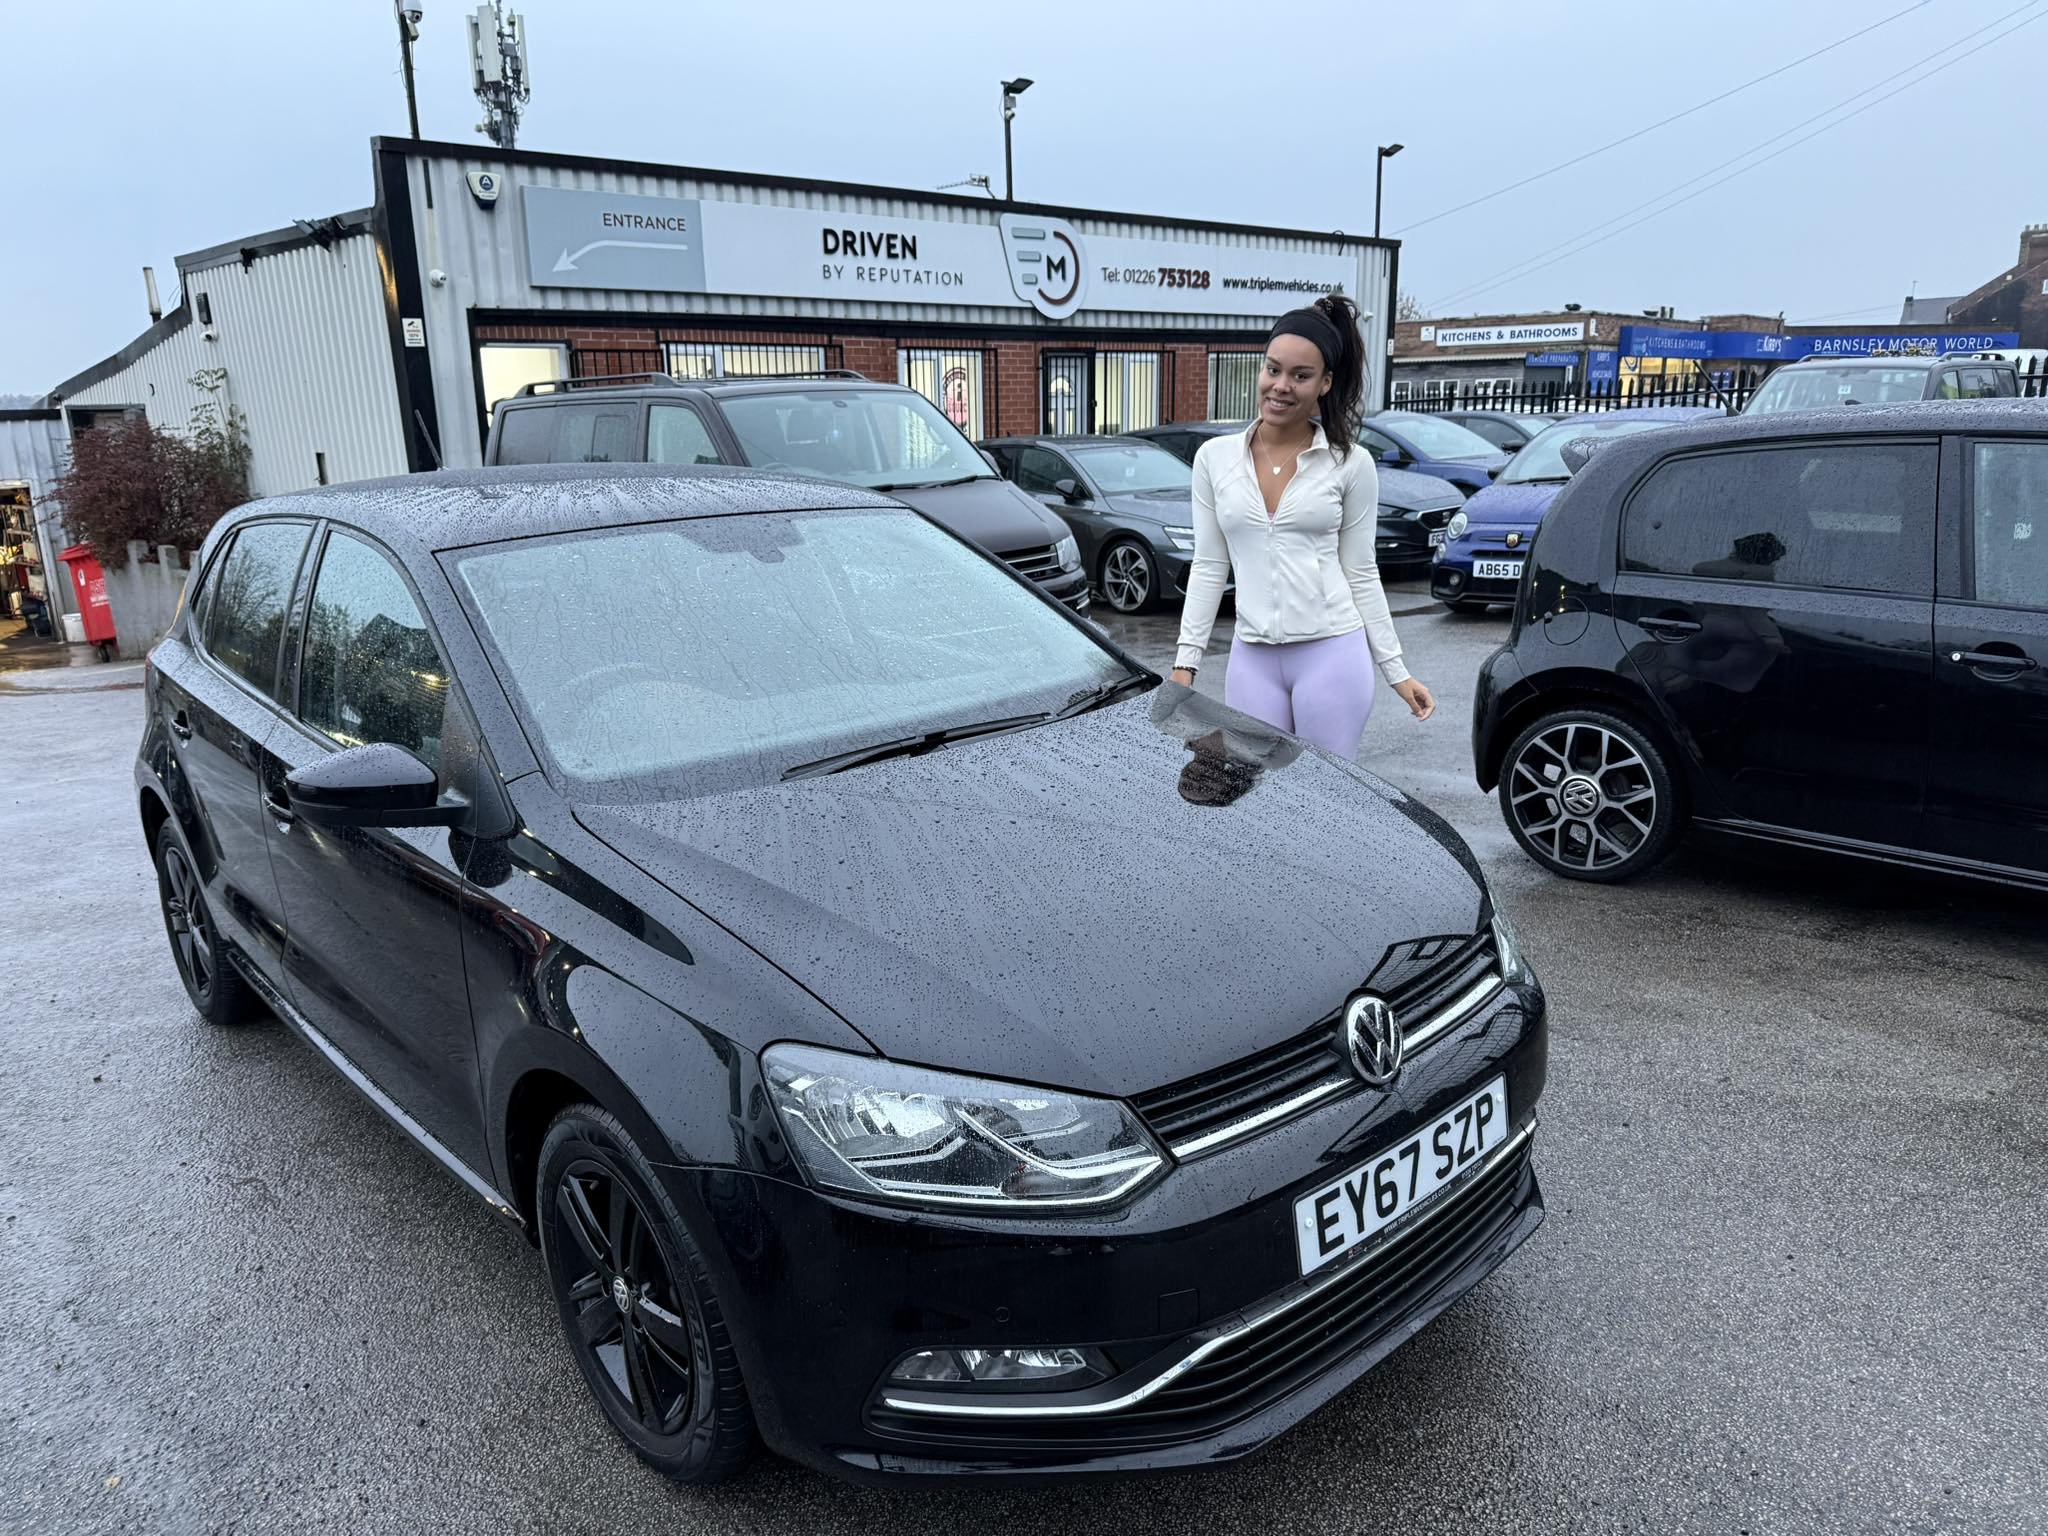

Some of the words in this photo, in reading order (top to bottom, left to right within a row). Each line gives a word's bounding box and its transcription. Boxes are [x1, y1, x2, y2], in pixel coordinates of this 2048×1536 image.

[603, 212, 686, 232] ENTRANCE
[822, 228, 917, 260] DRIVEN
[822, 264, 844, 280] BY
[856, 266, 963, 286] REPUTATION
[1101, 266, 1121, 283] Tel:
[1123, 267, 1156, 285] 01226
[1158, 267, 1211, 289] 753128
[1441, 331, 1492, 342] KITCHENS
[1496, 330, 1505, 340] &
[1510, 327, 1578, 340] BATHROOMS
[1813, 338, 1886, 352] BARNSLEY
[1888, 337, 1938, 352] MOTOR
[1944, 337, 1993, 350] WORLD
[1478, 562, 1509, 576] AB65
[1314, 1139, 1420, 1257] EY67
[1432, 1091, 1493, 1180] SZP
